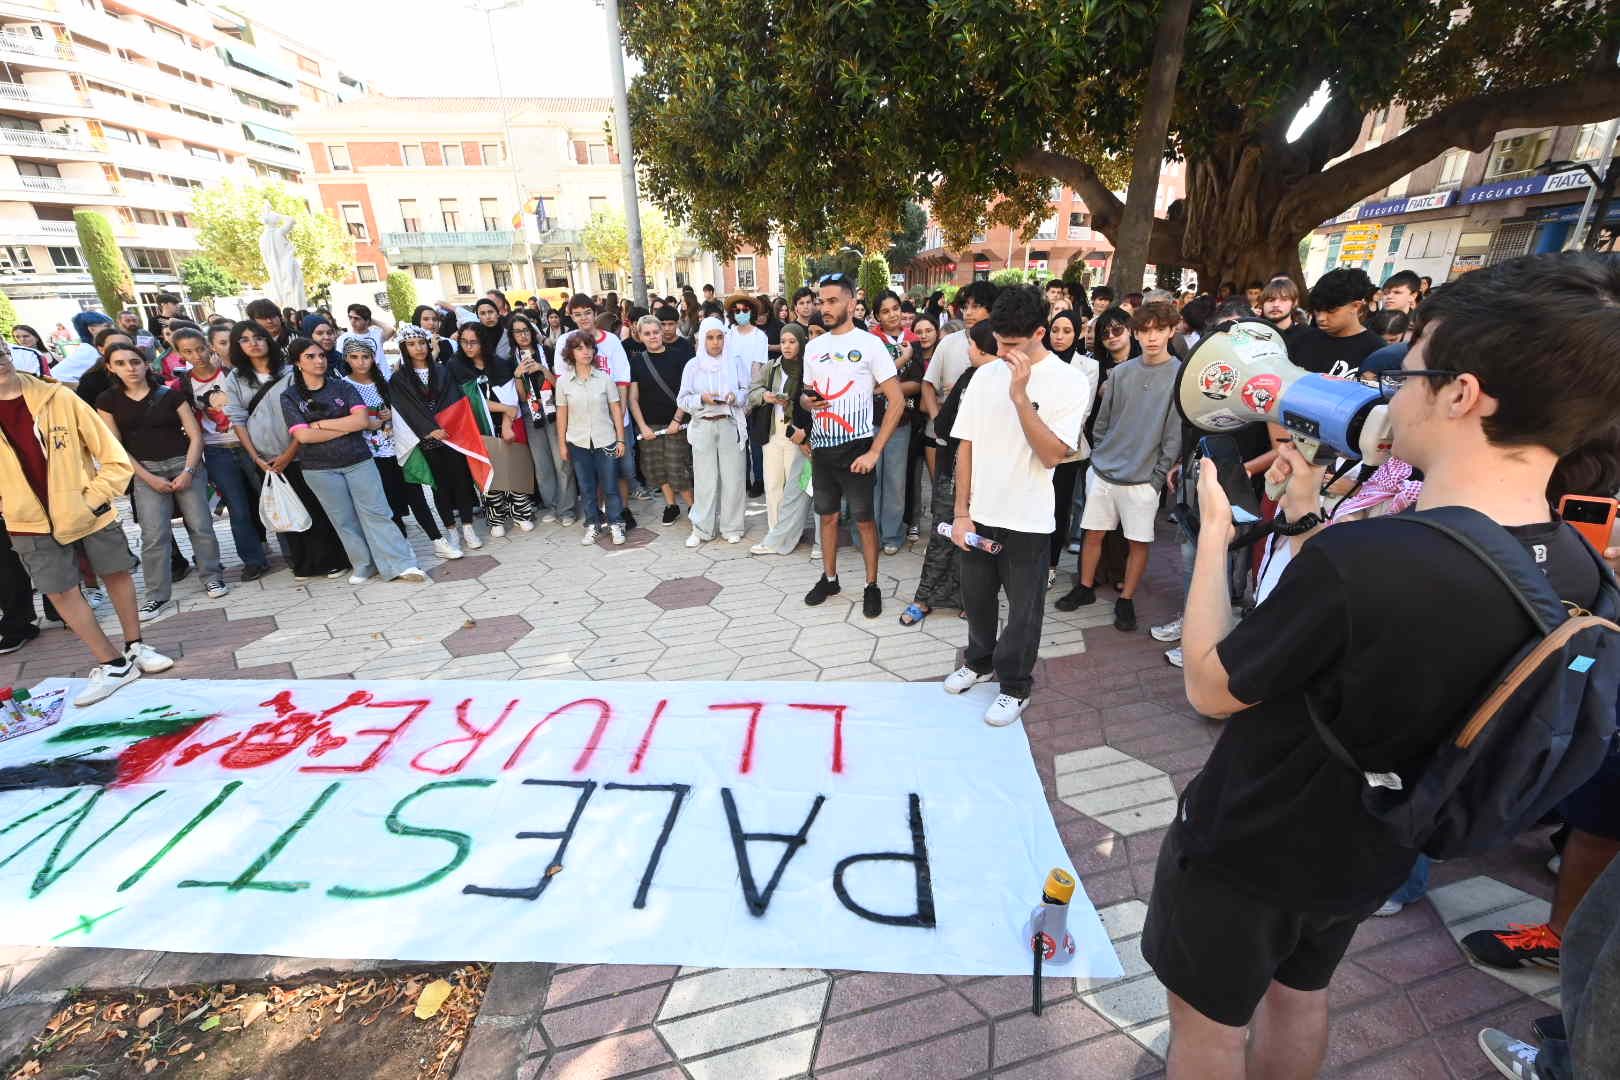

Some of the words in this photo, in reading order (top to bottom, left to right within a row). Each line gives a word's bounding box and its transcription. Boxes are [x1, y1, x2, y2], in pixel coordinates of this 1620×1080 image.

[1470, 183, 1535, 201] SEGUROS
[1364, 203, 1406, 217] SEGUROS
[1408, 196, 1436, 210] FIATC
[299, 697, 848, 775] LLIURE
